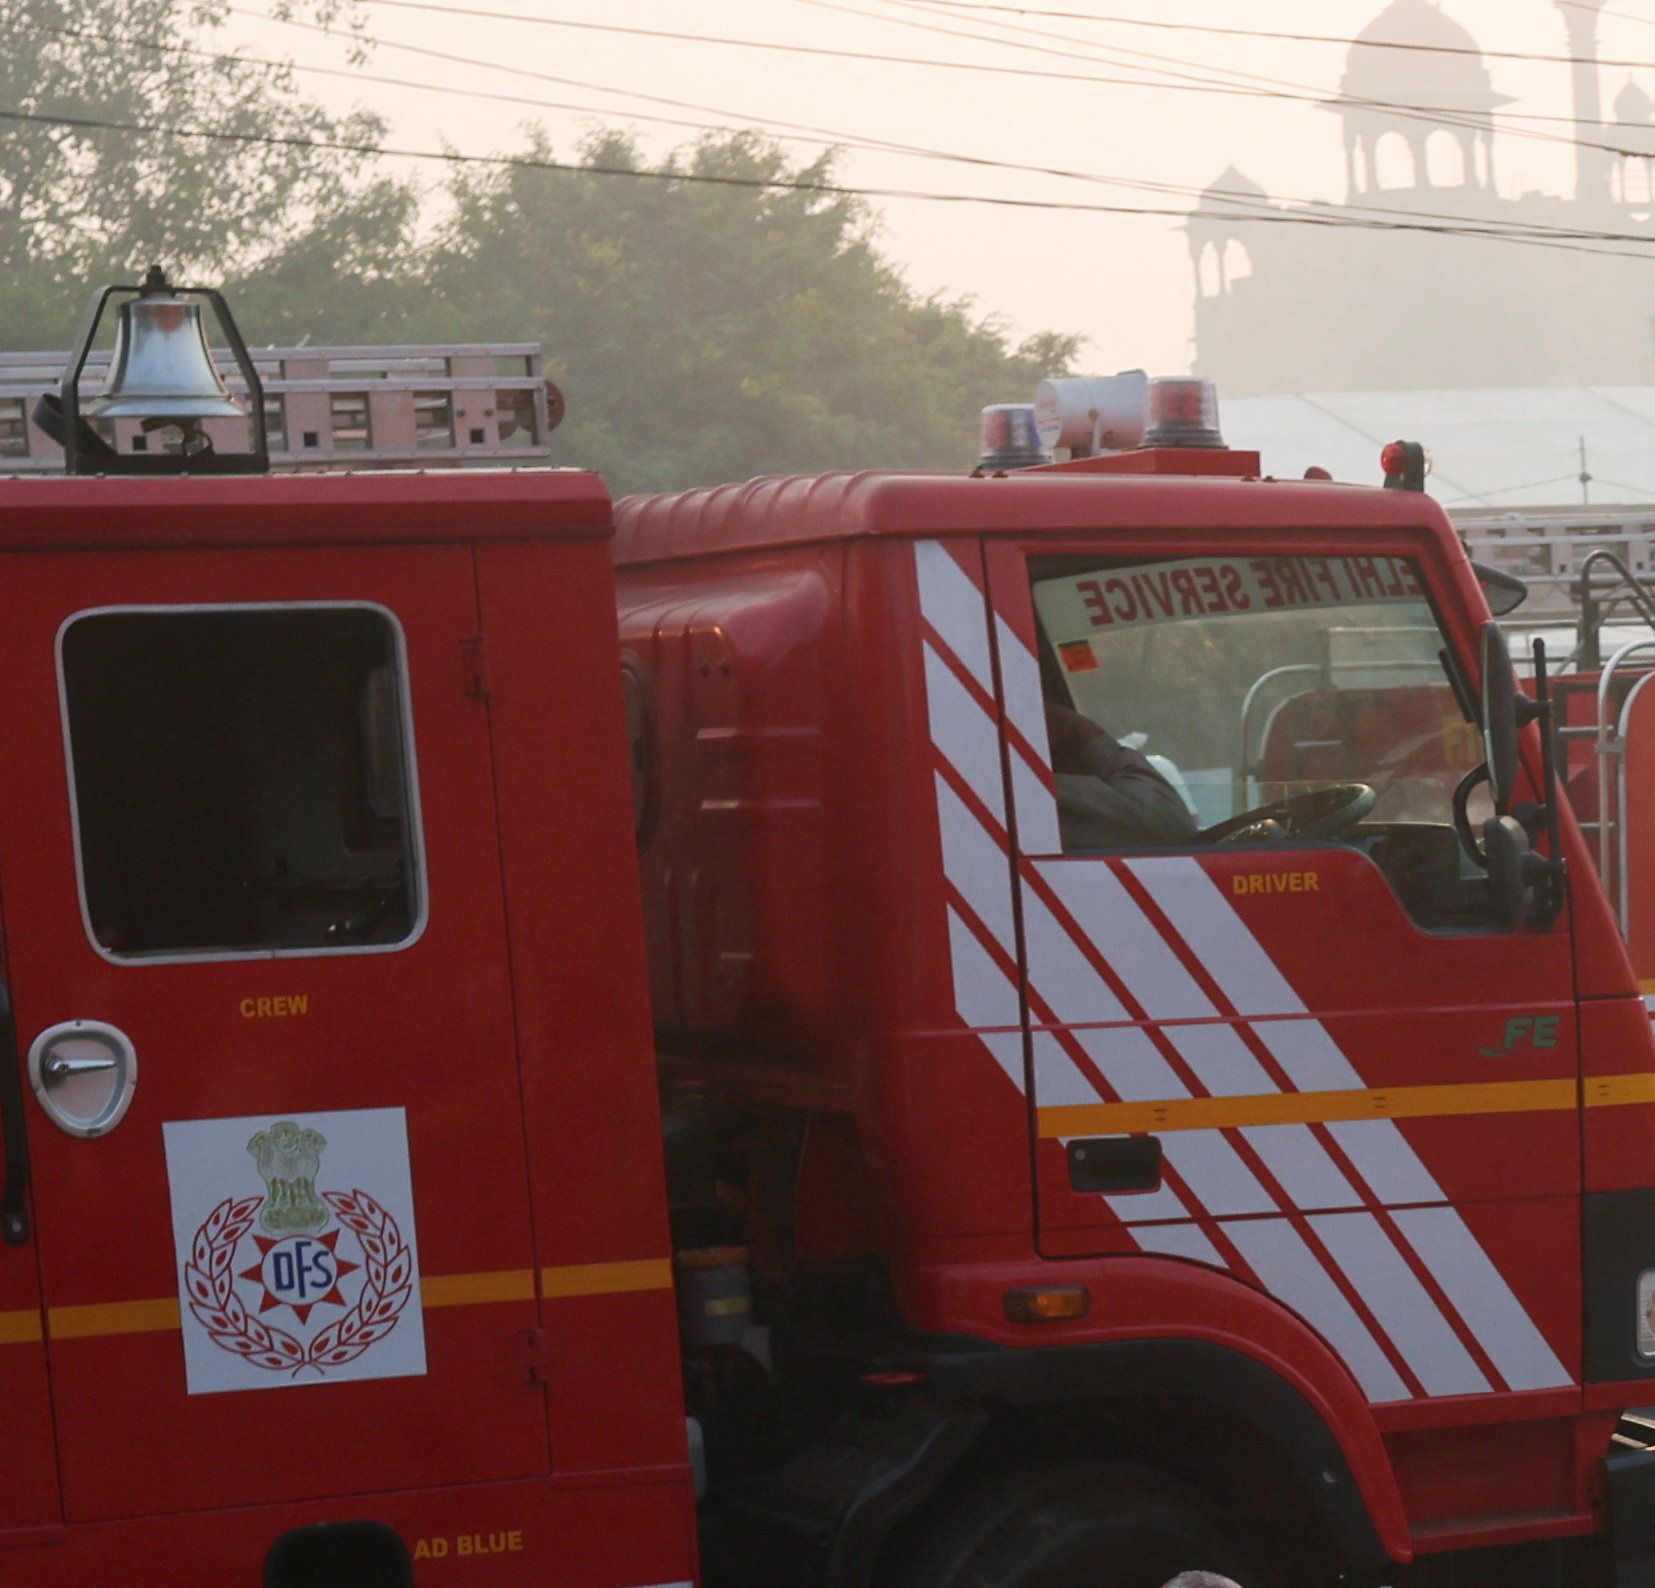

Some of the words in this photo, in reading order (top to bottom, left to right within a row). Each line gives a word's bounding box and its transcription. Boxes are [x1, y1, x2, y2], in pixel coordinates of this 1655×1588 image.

[1232, 871, 1319, 894] DRIVER
[240, 995, 308, 1018] CREW
[272, 1240, 333, 1298] DFS
[414, 1538, 448, 1560] AD
[457, 1530, 523, 1556] BLUE
